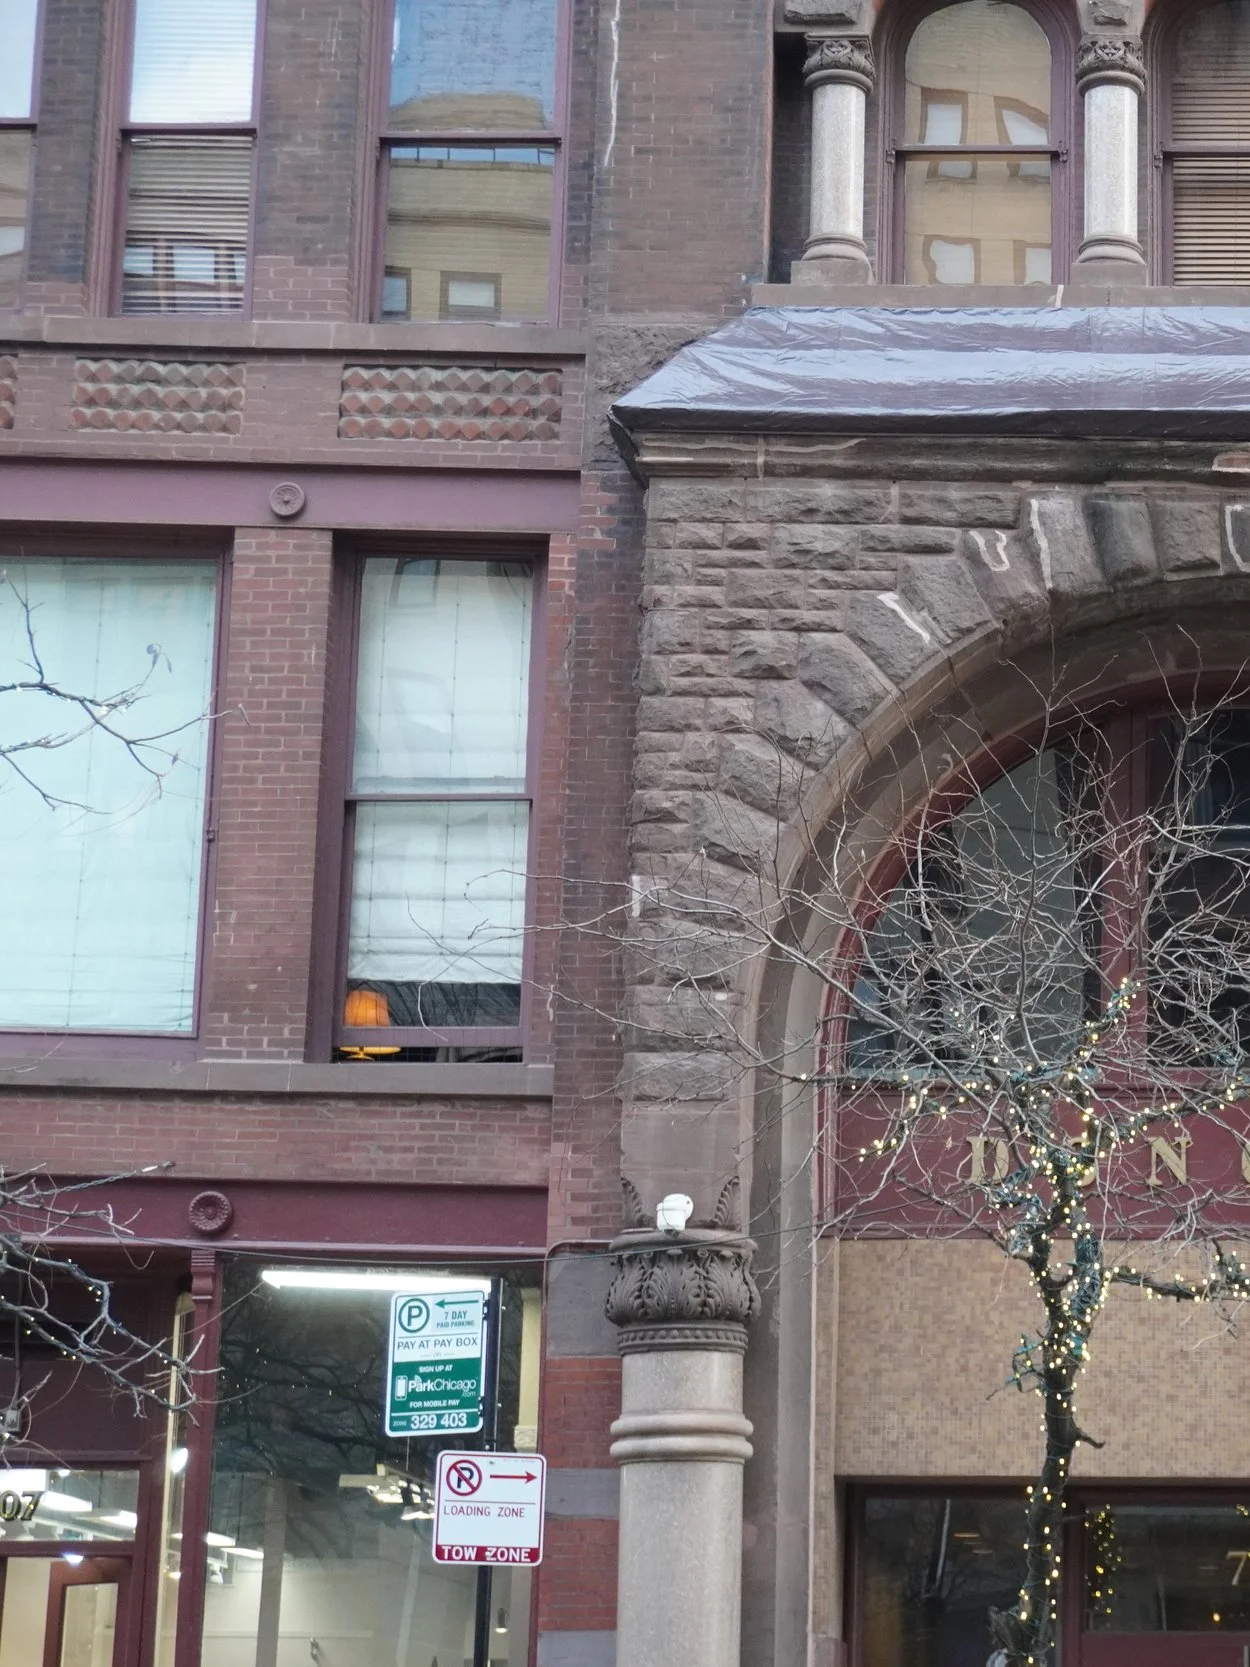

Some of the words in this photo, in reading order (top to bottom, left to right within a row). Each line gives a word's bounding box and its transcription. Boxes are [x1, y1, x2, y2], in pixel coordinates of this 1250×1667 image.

[452, 1310, 468, 1319] DAY
[397, 1341, 416, 1350] PAY
[418, 1340, 430, 1349] AT
[434, 1338, 452, 1348] PAY
[456, 1337, 478, 1346] BOX
[445, 1364, 453, 1372] AT
[408, 1378, 476, 1392] ParkChicago
[424, 1400, 447, 1408] MOBILE
[410, 1414, 437, 1429] 329
[440, 1412, 467, 1428] 403
[444, 1506, 491, 1516] LOADING
[497, 1506, 526, 1518] ZONE
[442, 1546, 477, 1560] TOW
[486, 1547, 531, 1562] ZONE
